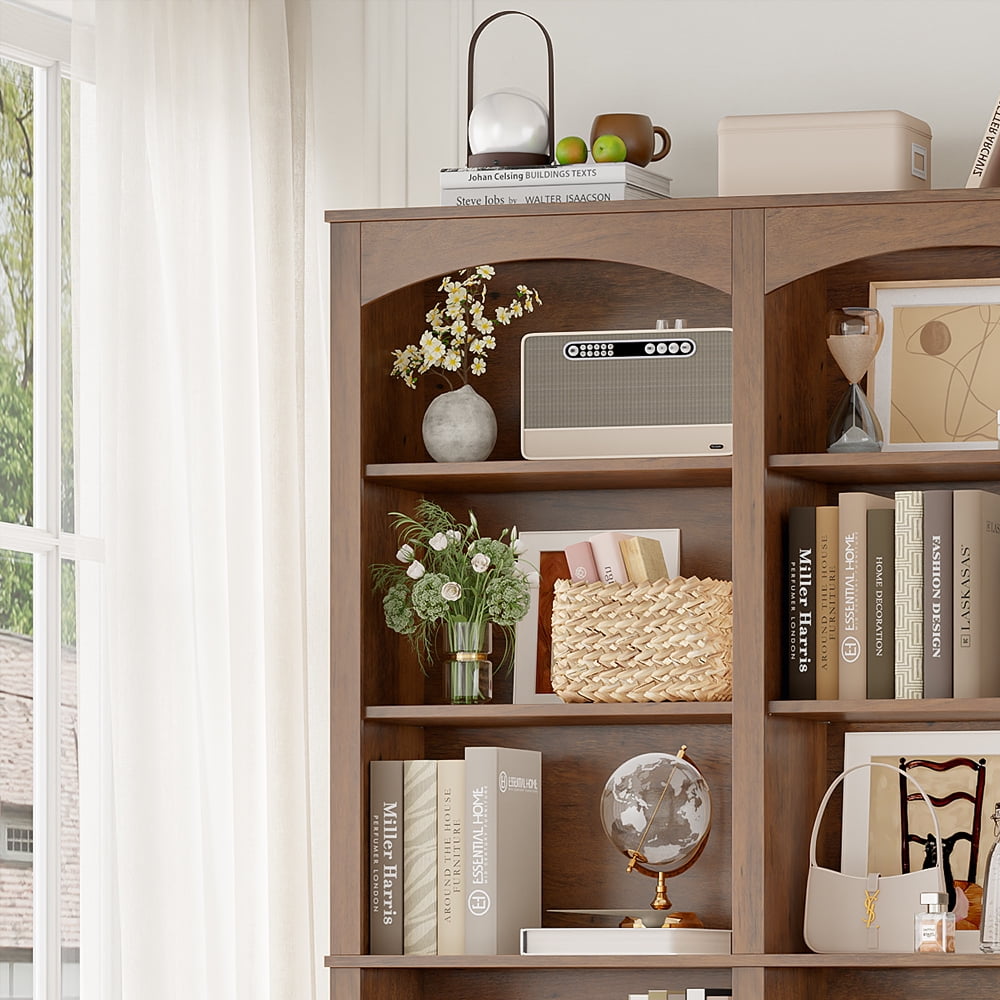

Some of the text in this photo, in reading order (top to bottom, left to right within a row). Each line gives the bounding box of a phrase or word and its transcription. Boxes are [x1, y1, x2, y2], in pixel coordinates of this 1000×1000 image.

[456, 195, 482, 207] Steve
[484, 194, 505, 206] Jobs
[525, 193, 562, 204] WALTER
[565, 192, 611, 203] ISAACSON
[467, 168, 597, 182] Johan Celsing BUILDINGS TEXTS
[798, 548, 812, 673] Miller Harris
[845, 532, 855, 631] ESSENTIAL HOME
[875, 556, 883, 657] HOME DECORATION
[932, 535, 941, 658] FASHION DESIGN
[960, 546, 971, 631] LASKASAS
[383, 801, 398, 926] Miller Harris
[444, 788, 452, 924] AROUND THE HOUSE
[453, 819, 461, 893] FURNITURE
[472, 786, 484, 885] ESSENTIAL HOME
